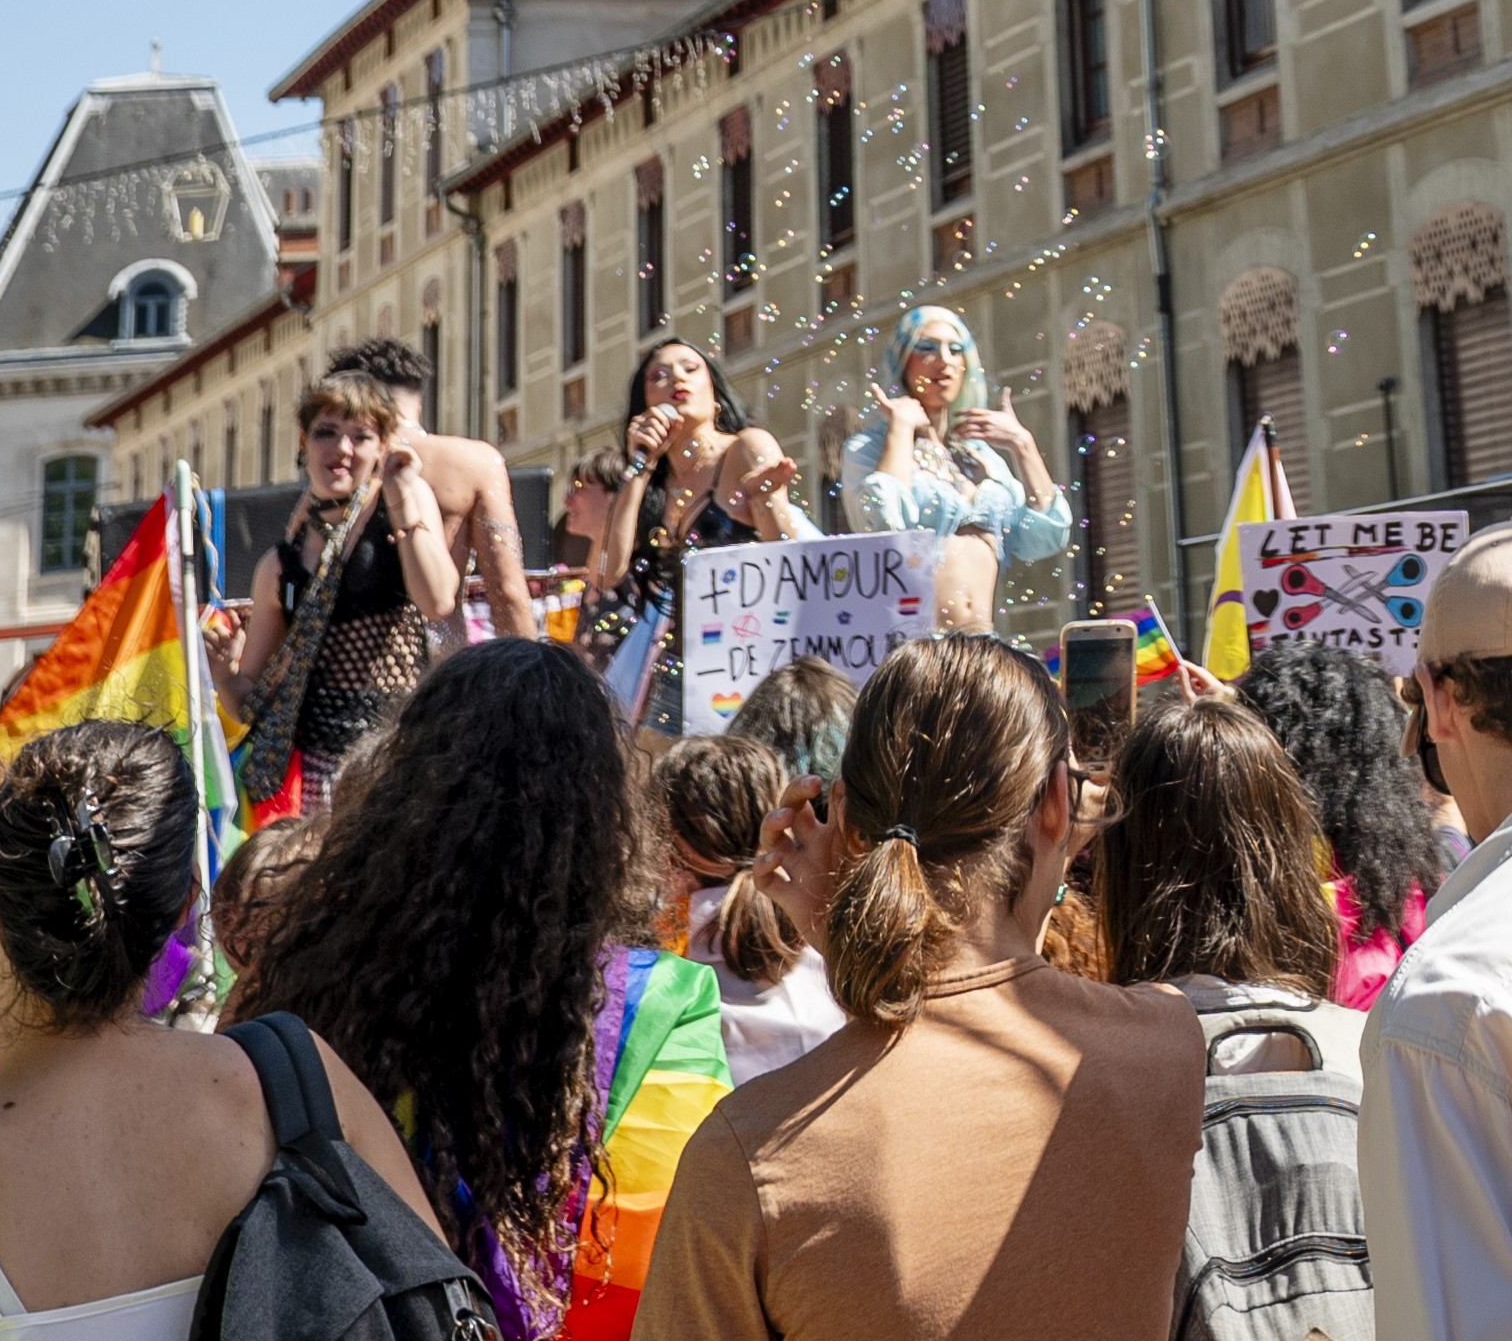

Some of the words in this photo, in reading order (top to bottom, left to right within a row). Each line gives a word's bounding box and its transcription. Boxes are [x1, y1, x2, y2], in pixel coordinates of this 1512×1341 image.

[1260, 523, 1333, 558] LET
[1353, 521, 1404, 547] ME
[1415, 521, 1460, 553] BE
[740, 548, 909, 608] D'AMOUR
[729, 644, 759, 682] DE
